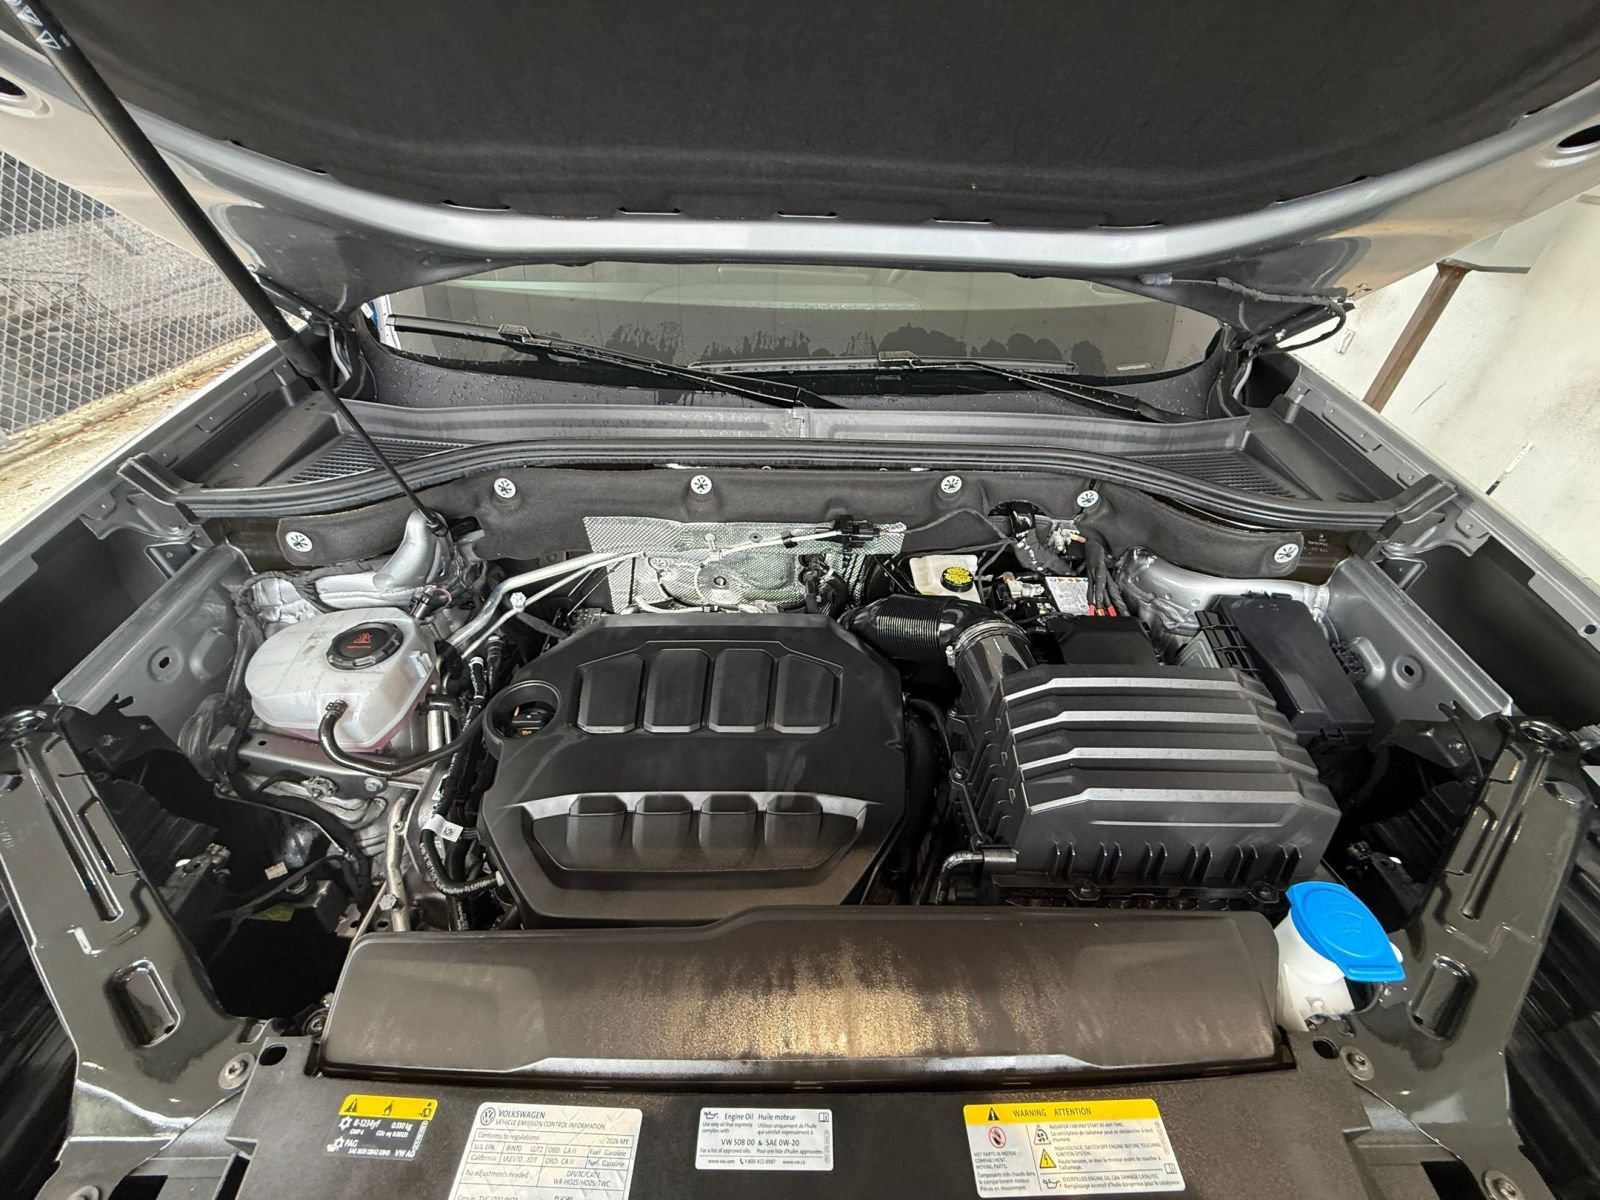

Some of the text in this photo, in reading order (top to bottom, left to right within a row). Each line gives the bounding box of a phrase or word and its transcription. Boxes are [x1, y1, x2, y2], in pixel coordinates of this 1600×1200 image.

[498, 1109, 545, 1119] VOLKSWAGEN
[1013, 1109, 1046, 1118] WARNING
[1054, 1107, 1092, 1116] ATTENTION
[724, 1112, 754, 1122] Engine Oil
[568, 1122, 606, 1130] INFORMATION
[344, 1139, 358, 1148] PAG
[395, 1149, 406, 1157] VW
[405, 1150, 416, 1158] AG
